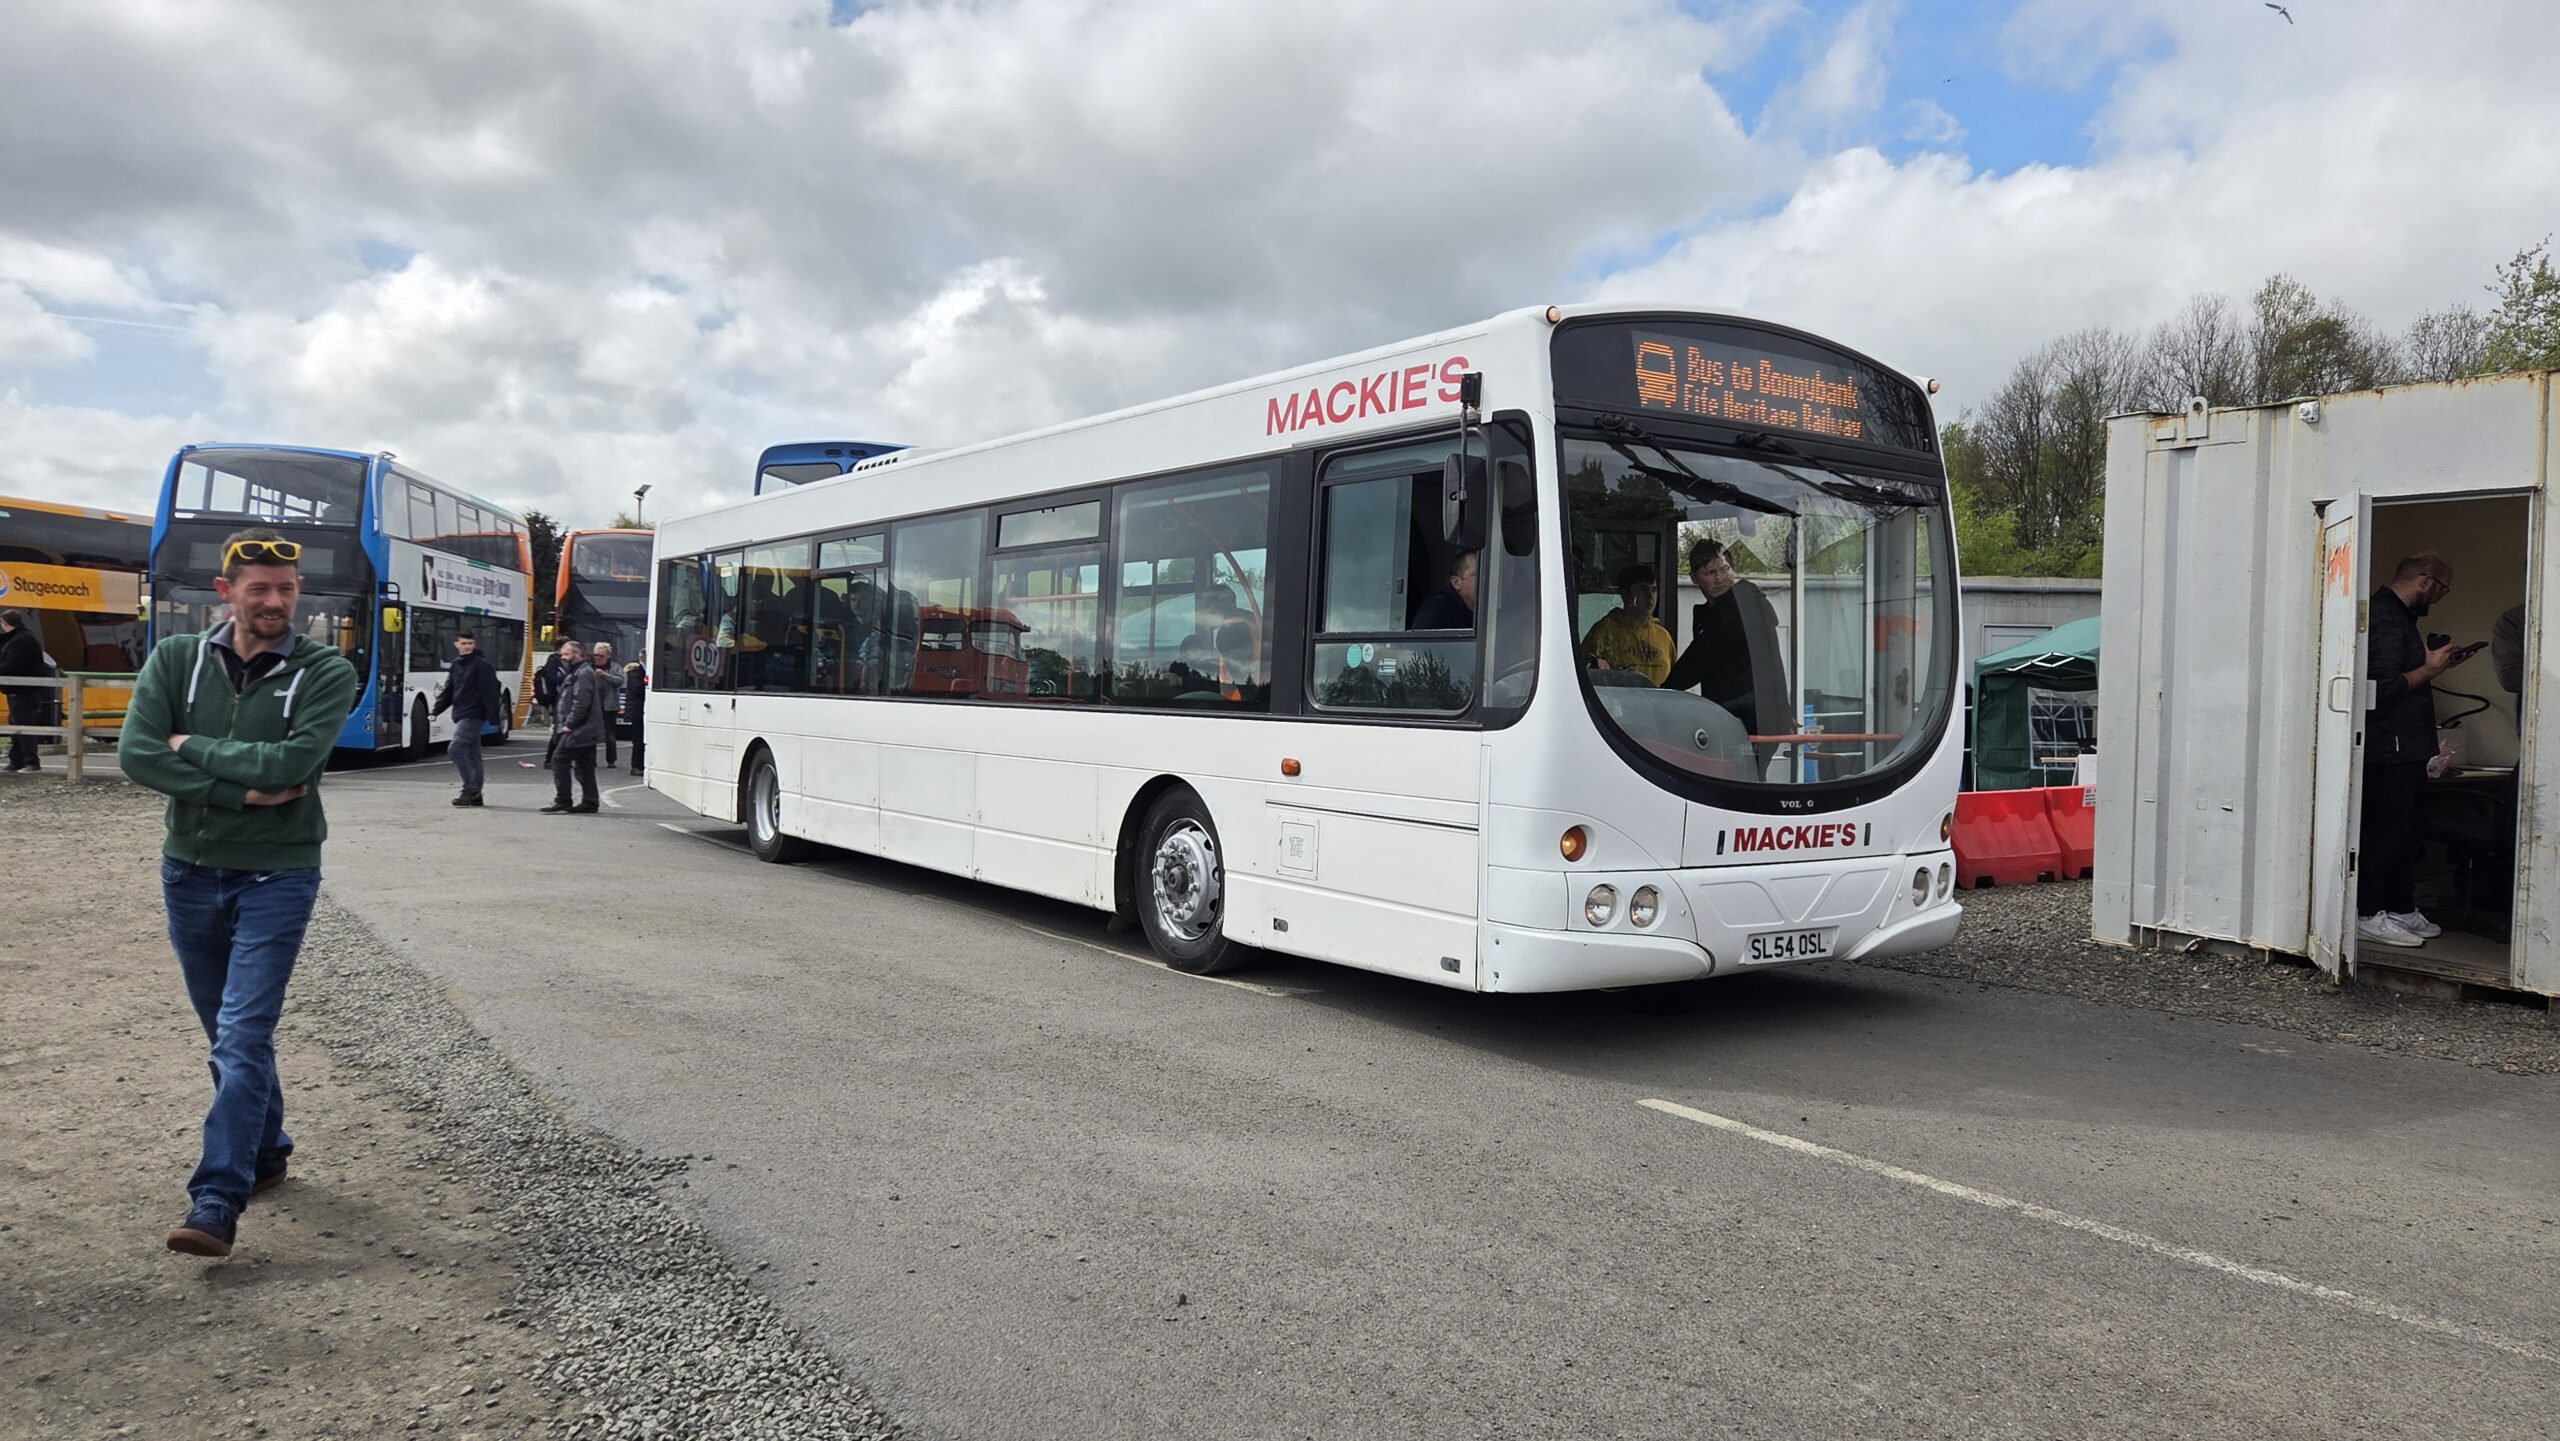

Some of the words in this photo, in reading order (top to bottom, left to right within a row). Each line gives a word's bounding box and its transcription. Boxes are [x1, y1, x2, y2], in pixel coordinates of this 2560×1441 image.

[1266, 355, 1470, 436] MACKIE'S
[1687, 346, 1724, 385] Bus
[1731, 361, 1753, 391] to
[1759, 359, 1858, 409] Bonnybank
[1683, 383, 1719, 415] Fife
[1723, 390, 1798, 428] Heritage
[1802, 403, 1861, 438] Railway
[13, 576, 90, 597] Stagecoach
[1733, 822, 1856, 852] MACKIE'S
[1752, 936, 1794, 960] SL54
[1799, 933, 1827, 955] OSL
